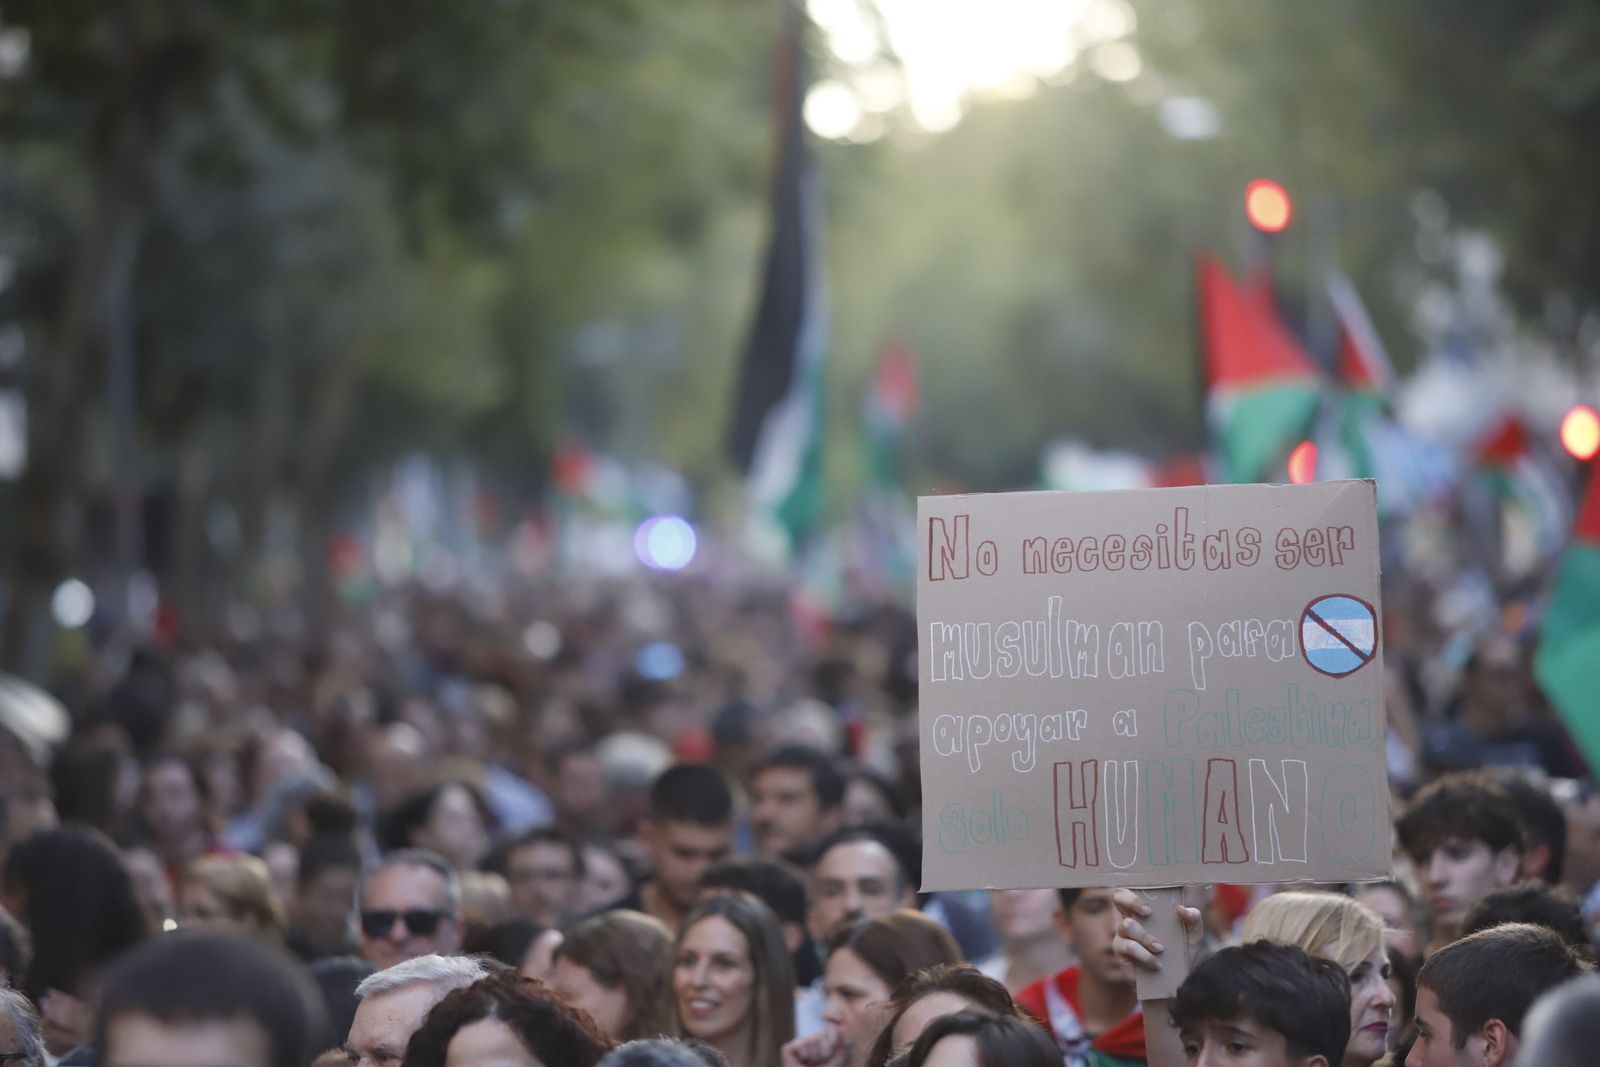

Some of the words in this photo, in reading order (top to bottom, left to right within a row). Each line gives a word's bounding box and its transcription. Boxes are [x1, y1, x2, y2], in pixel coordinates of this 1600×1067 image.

[928, 514, 999, 581] No
[1022, 506, 1262, 574] necesitas
[1274, 525, 1356, 570] ser
[929, 595, 1165, 683] musulman
[1187, 617, 1297, 690] para
[931, 708, 1088, 774] apoyar
[1112, 708, 1138, 737] a
[1052, 758, 1376, 869] HUMANO
